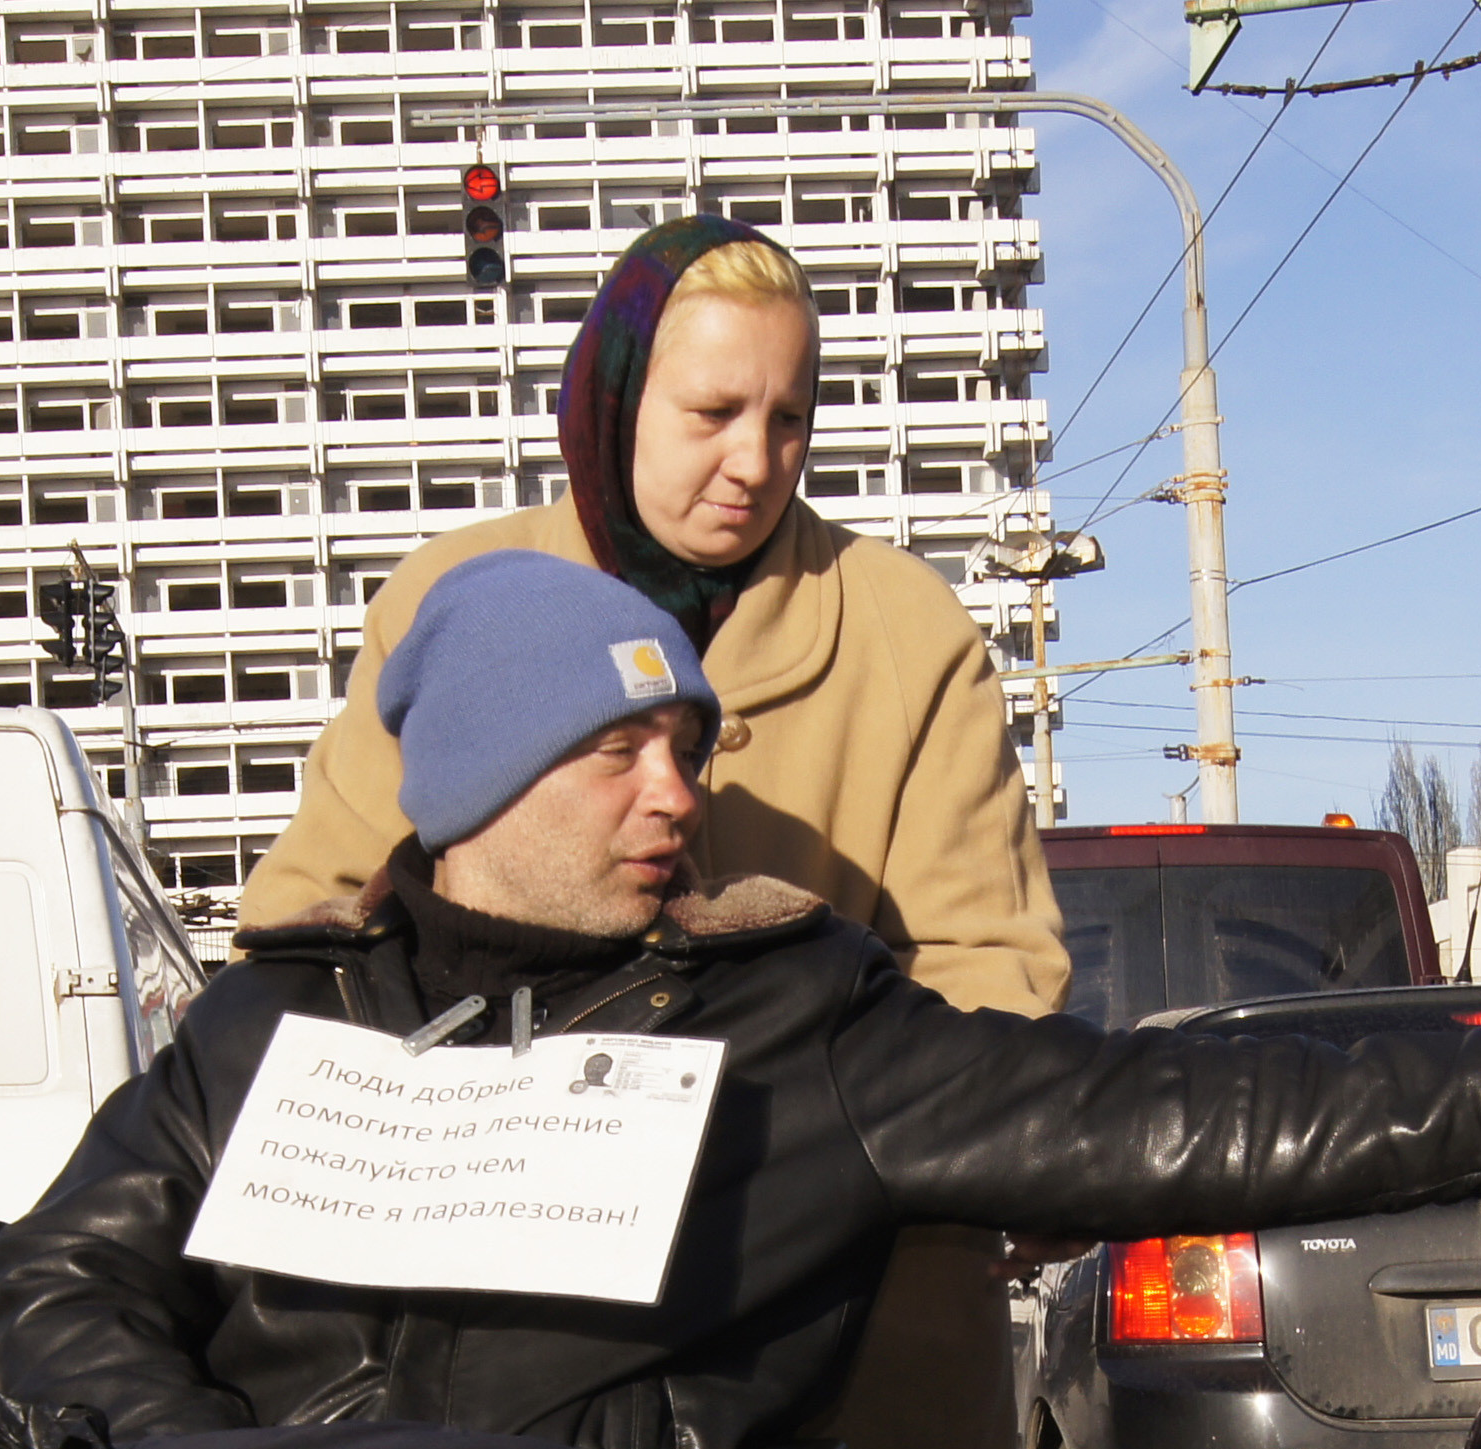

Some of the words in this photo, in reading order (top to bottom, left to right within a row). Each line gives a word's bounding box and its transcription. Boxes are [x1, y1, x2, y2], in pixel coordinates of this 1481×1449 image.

[309, 1058, 404, 1098] Люди
[412, 1076, 534, 1105] добрые
[276, 1098, 432, 1142] помогите
[443, 1122, 477, 1142] на
[484, 1114, 623, 1135] лечение
[260, 1139, 457, 1182] пожалуйсто
[467, 1157, 526, 1174] чем
[242, 1181, 375, 1220] можите
[384, 1207, 403, 1222] я
[413, 1201, 639, 1227] паралезован!
[1300, 1238, 1357, 1251] TOYOTA
[1436, 1343, 1458, 1361] MD
